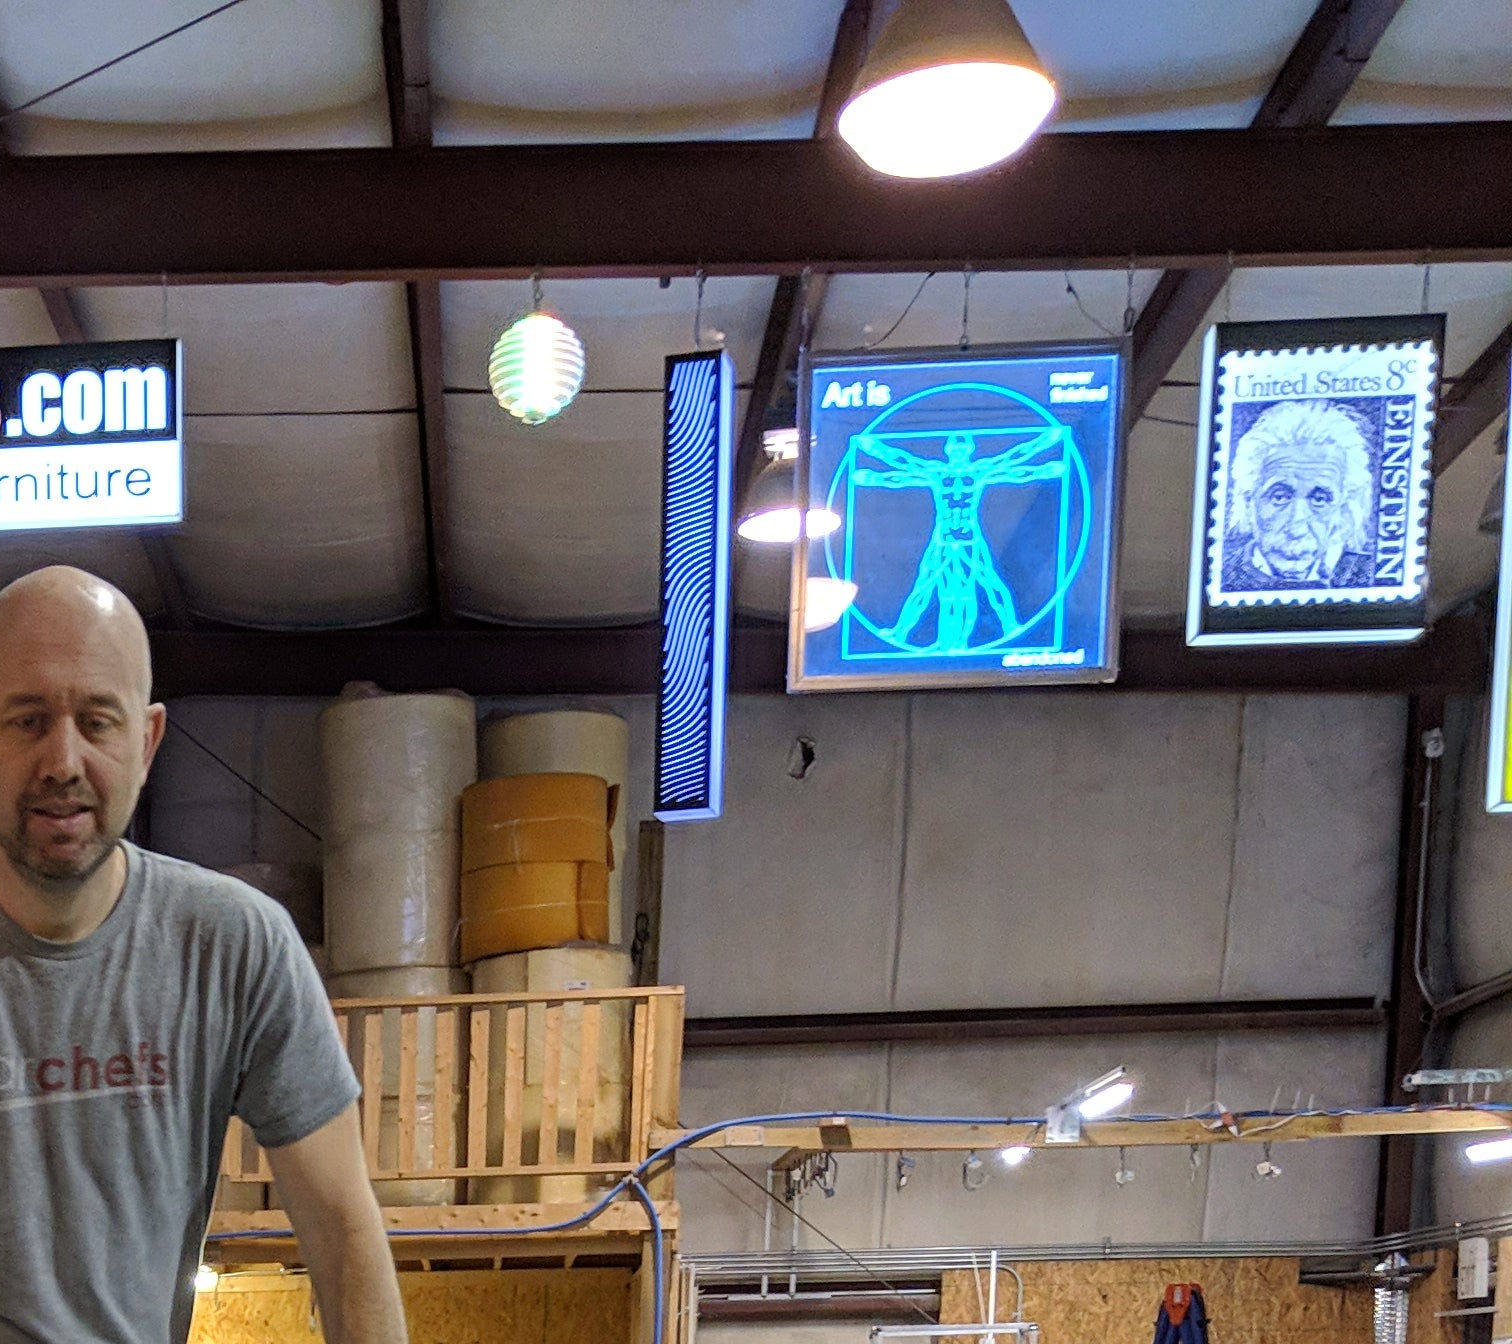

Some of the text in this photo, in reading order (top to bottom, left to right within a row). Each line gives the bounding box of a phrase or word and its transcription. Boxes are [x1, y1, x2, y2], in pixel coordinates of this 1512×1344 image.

[821, 380, 891, 408] Art is
[1234, 373, 1308, 398] United
[1314, 370, 1382, 395] States
[1375, 401, 1415, 582] EINSTEIN
